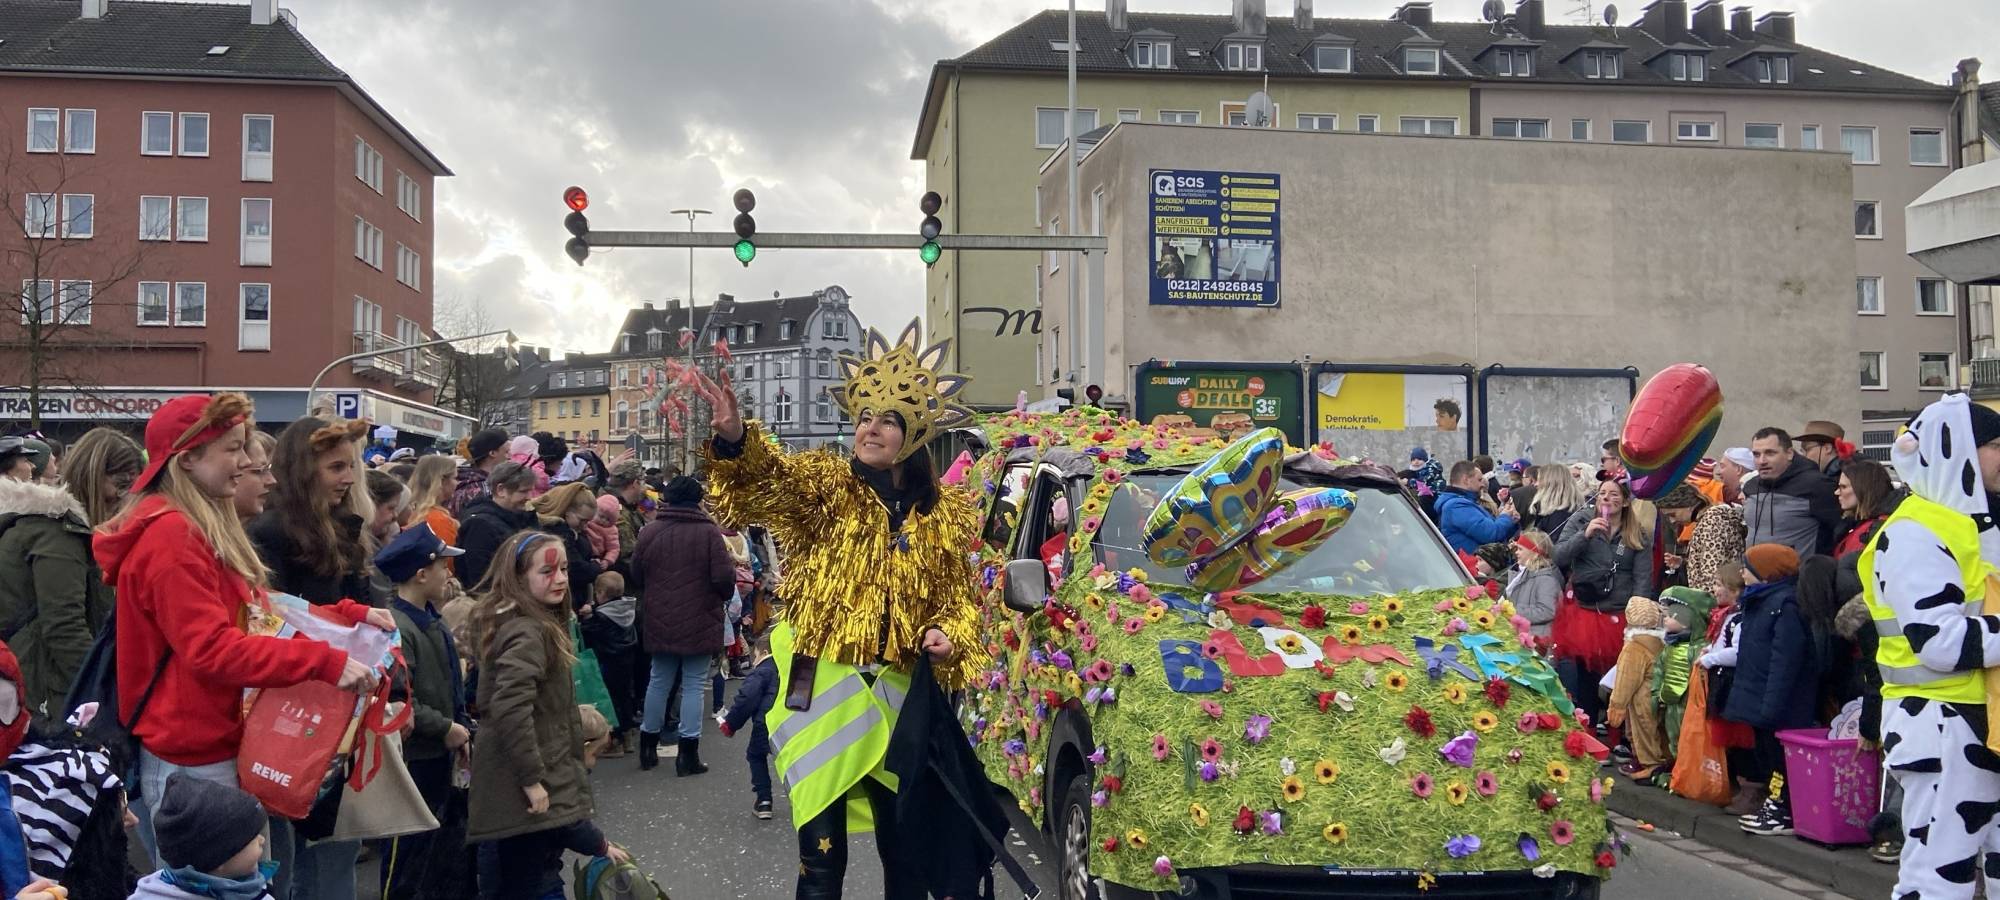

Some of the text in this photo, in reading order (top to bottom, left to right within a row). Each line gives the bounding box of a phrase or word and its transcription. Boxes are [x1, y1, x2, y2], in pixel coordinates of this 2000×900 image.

[1177, 176, 1205, 188] sas
[1157, 217, 1204, 225] LANGFRISTIGE
[1157, 226, 1217, 235] WERTERHALTUNG
[1167, 279, 1264, 292] (0212) 24926845
[1168, 291, 1263, 301] SAS-BAUTENSCHUTZ.DE
[1150, 376, 1191, 385] SUBWAY
[1199, 378, 1239, 389] DAILY
[1196, 392, 1251, 407] DEALS
[339, 396, 357, 418] P
[1325, 414, 1382, 424] Demokratie,
[251, 761, 292, 788] REWE
